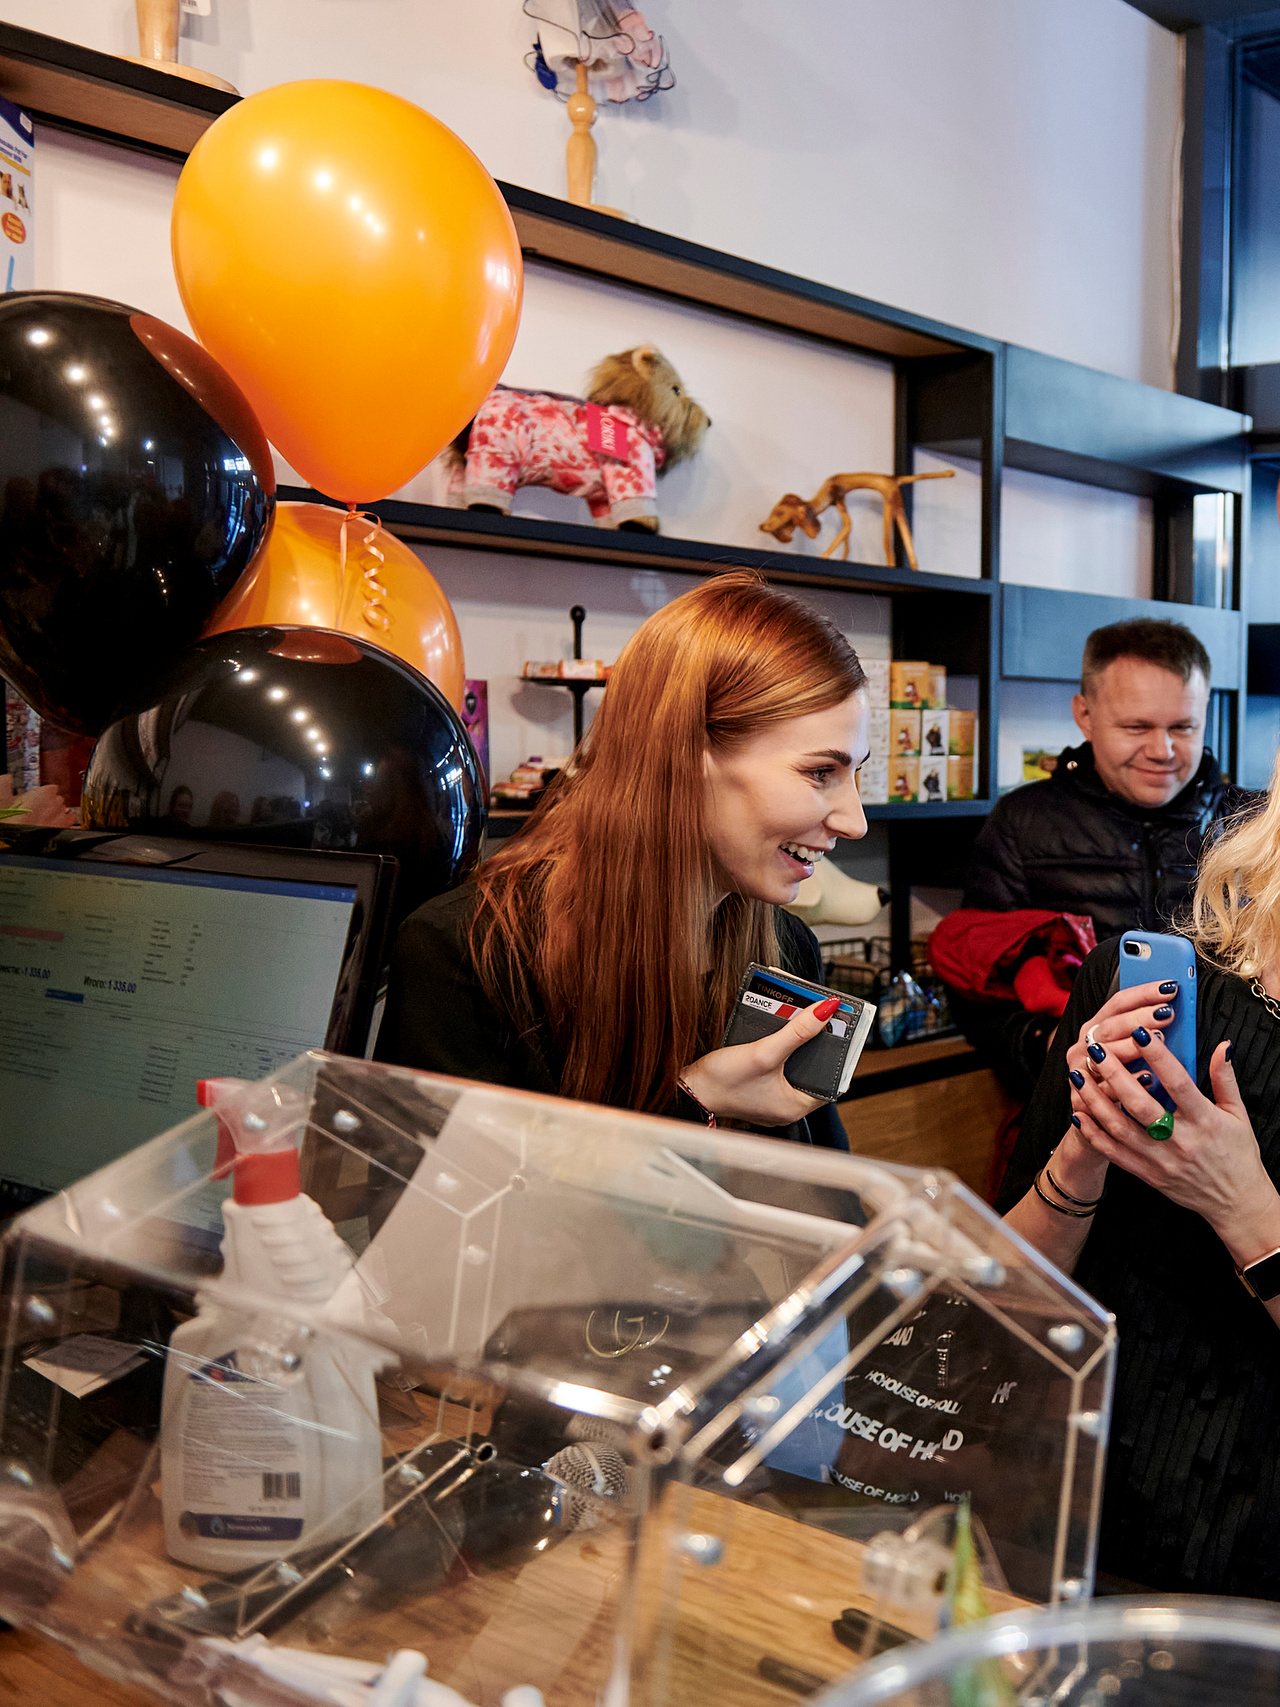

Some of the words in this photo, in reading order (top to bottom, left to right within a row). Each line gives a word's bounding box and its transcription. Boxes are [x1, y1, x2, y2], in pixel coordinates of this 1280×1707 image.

[745, 994, 773, 1009] 2DANCE
[756, 982, 794, 1003] TINKOFF
[818, 1401, 883, 1443] OUSE
[878, 1427, 913, 1453] OF
[863, 1485, 885, 1498] OF
